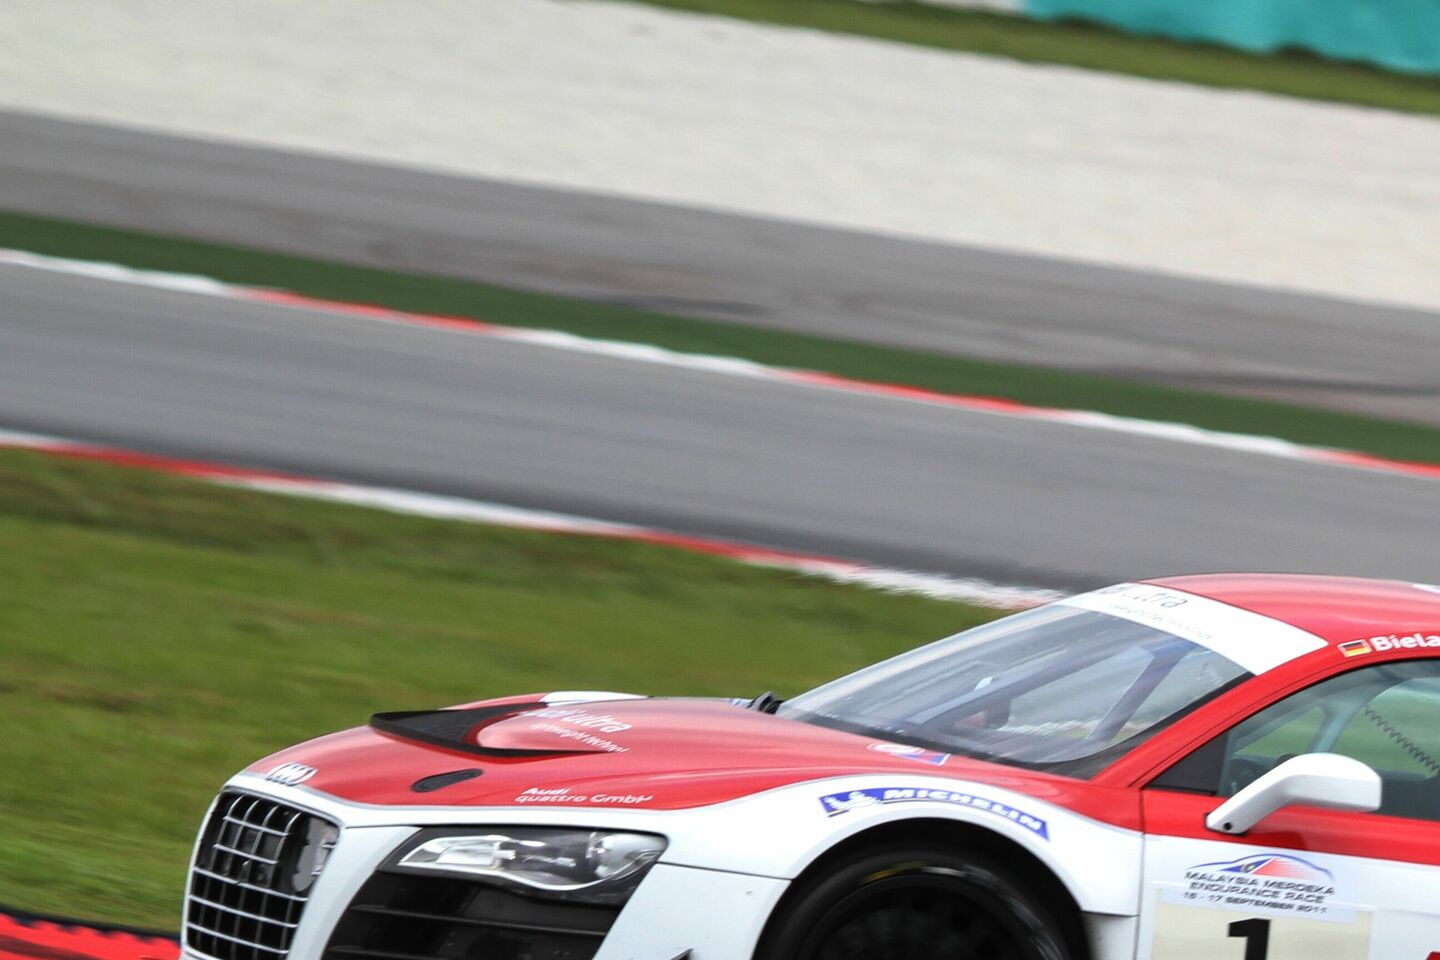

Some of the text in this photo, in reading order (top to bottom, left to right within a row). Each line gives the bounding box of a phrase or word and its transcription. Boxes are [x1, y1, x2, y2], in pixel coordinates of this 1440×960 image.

[515, 794, 654, 804] quattro GmbH
[522, 787, 571, 795] Audi
[883, 789, 1042, 831] MICHELIN
[1184, 871, 1335, 896] MALAYSIA MERDEKA
[1189, 881, 1326, 904] ENDURANCE RACE
